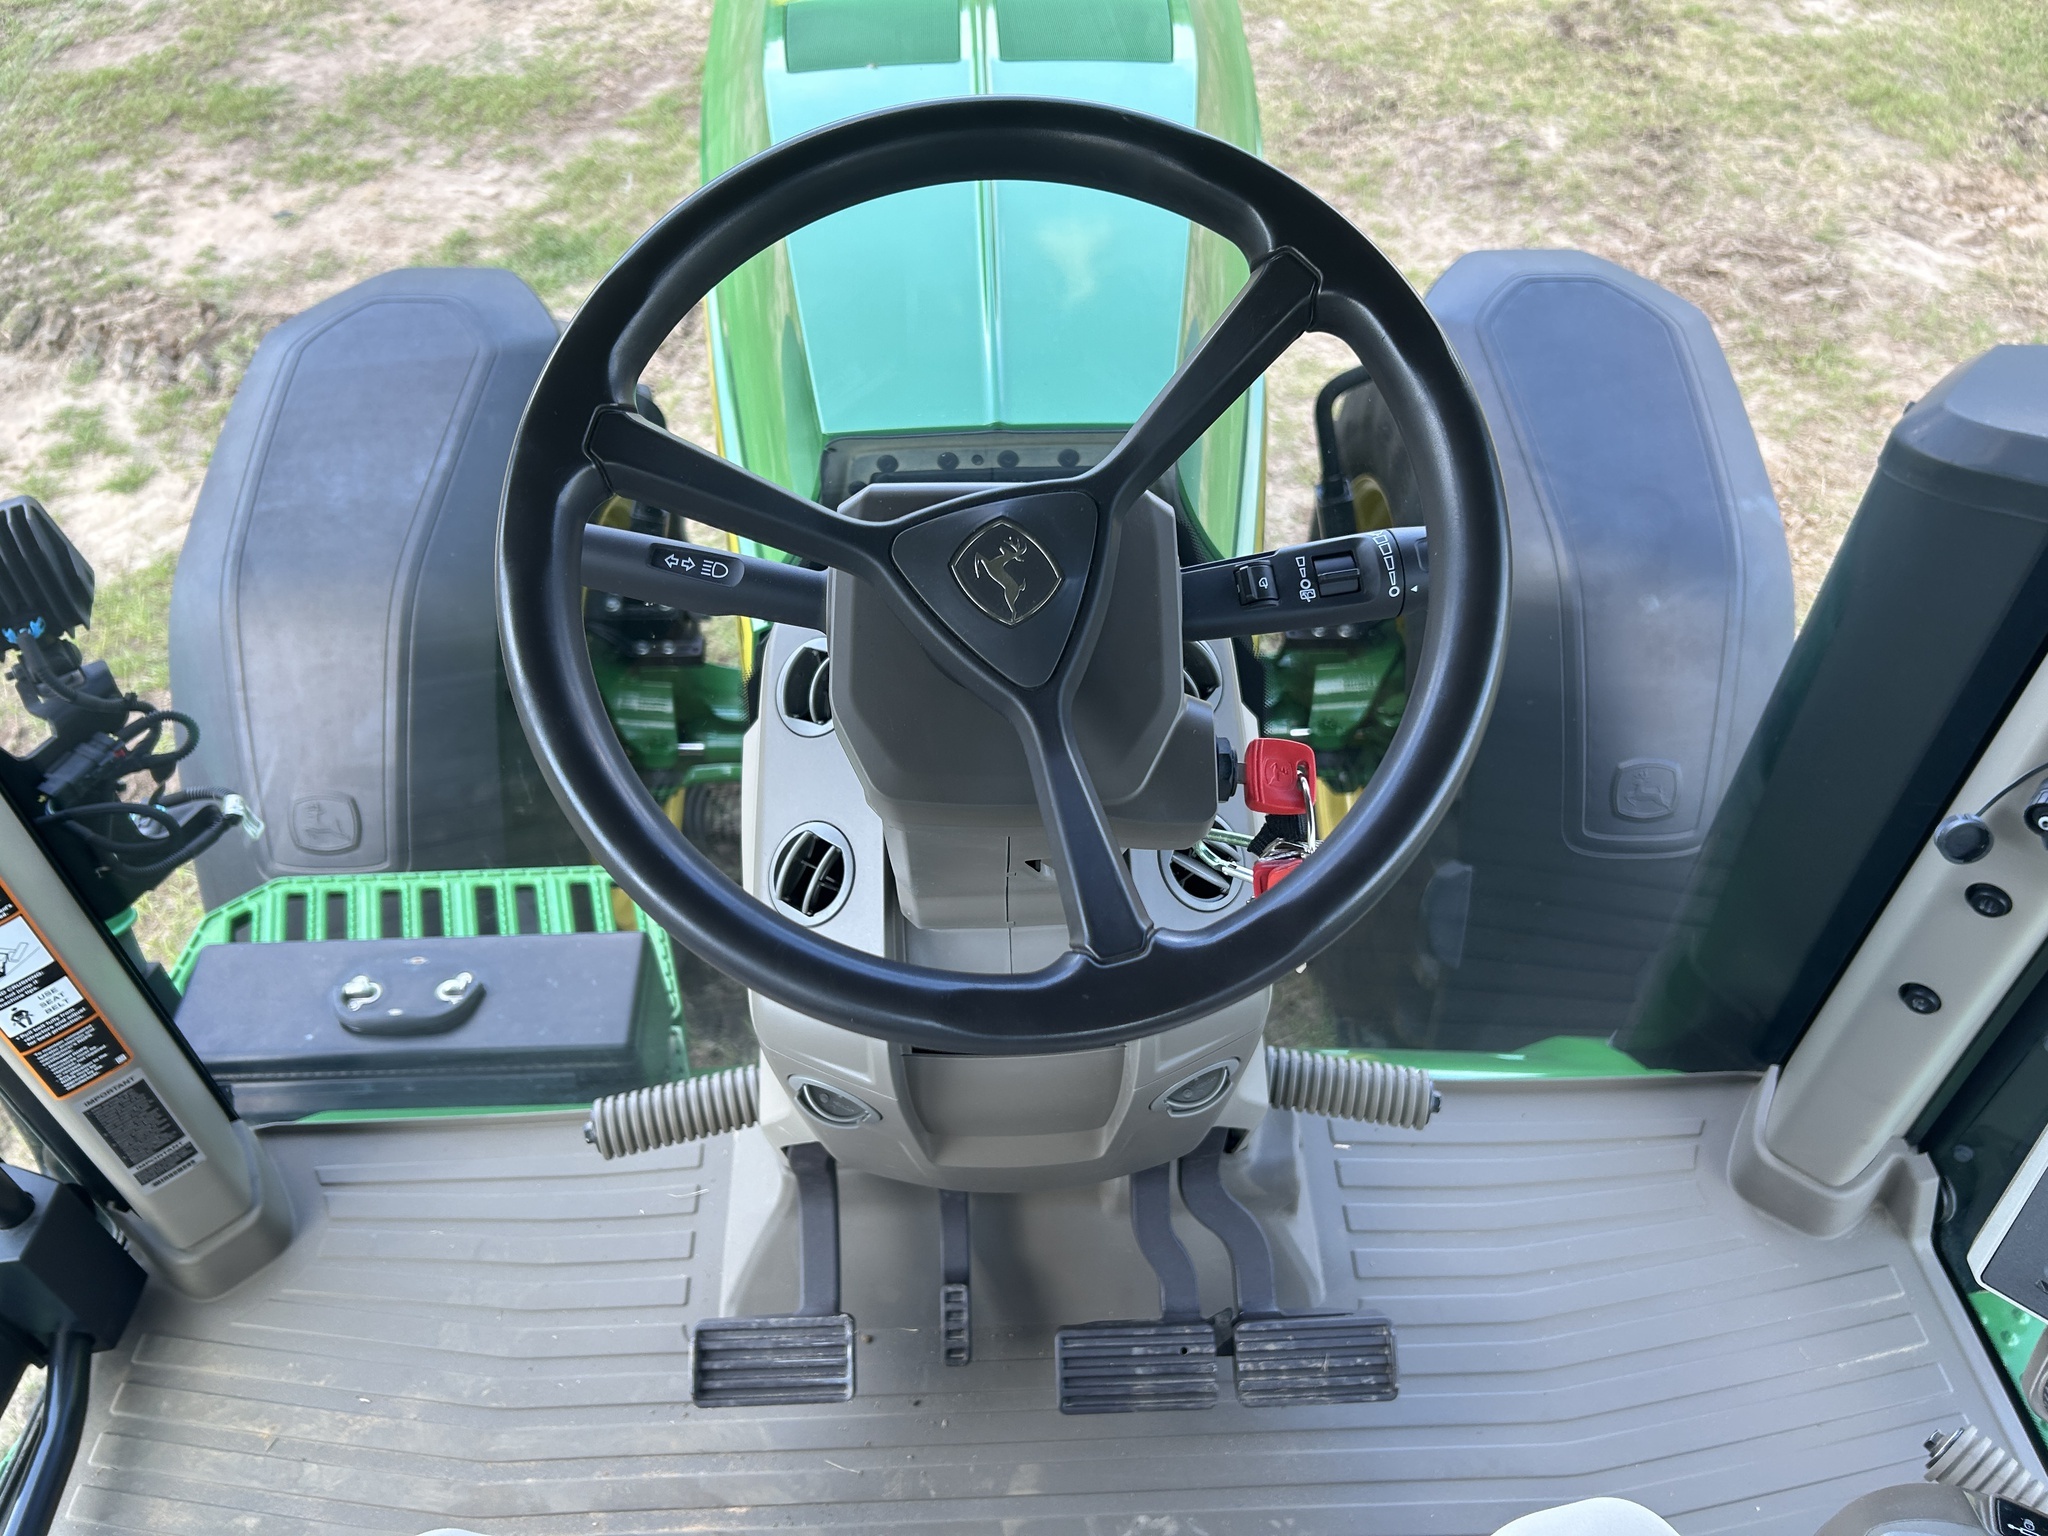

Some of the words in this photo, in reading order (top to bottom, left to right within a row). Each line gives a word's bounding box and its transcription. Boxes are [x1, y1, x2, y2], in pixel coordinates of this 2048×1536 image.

[37, 987, 58, 1001] USE
[39, 991, 65, 1008] SEAT
[45, 998, 69, 1014] BELT
[83, 1076, 135, 1107] IMPORTANT
